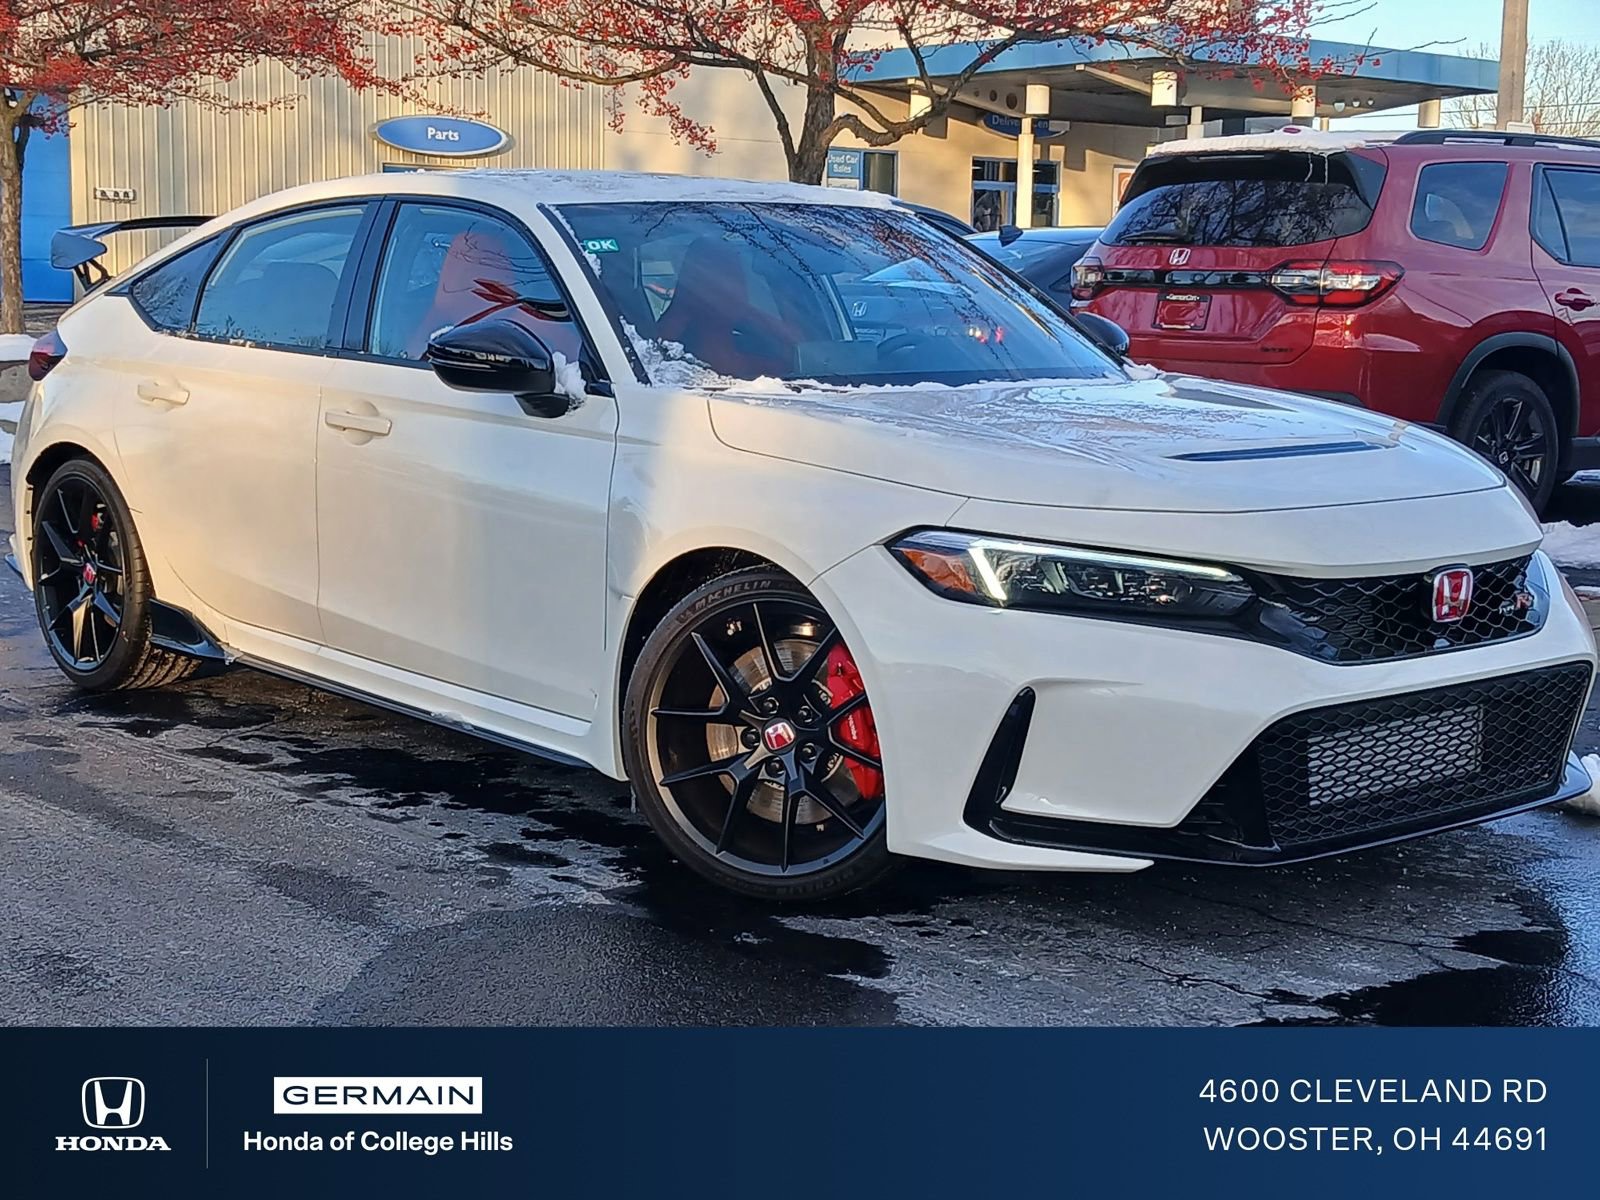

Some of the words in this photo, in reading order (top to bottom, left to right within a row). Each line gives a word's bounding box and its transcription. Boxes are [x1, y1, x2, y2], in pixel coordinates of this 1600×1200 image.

[991, 114, 1022, 127] Delive
[427, 127, 460, 141] Parts
[845, 154, 858, 164] Car
[833, 163, 852, 173] Sales
[586, 240, 616, 251] OK
